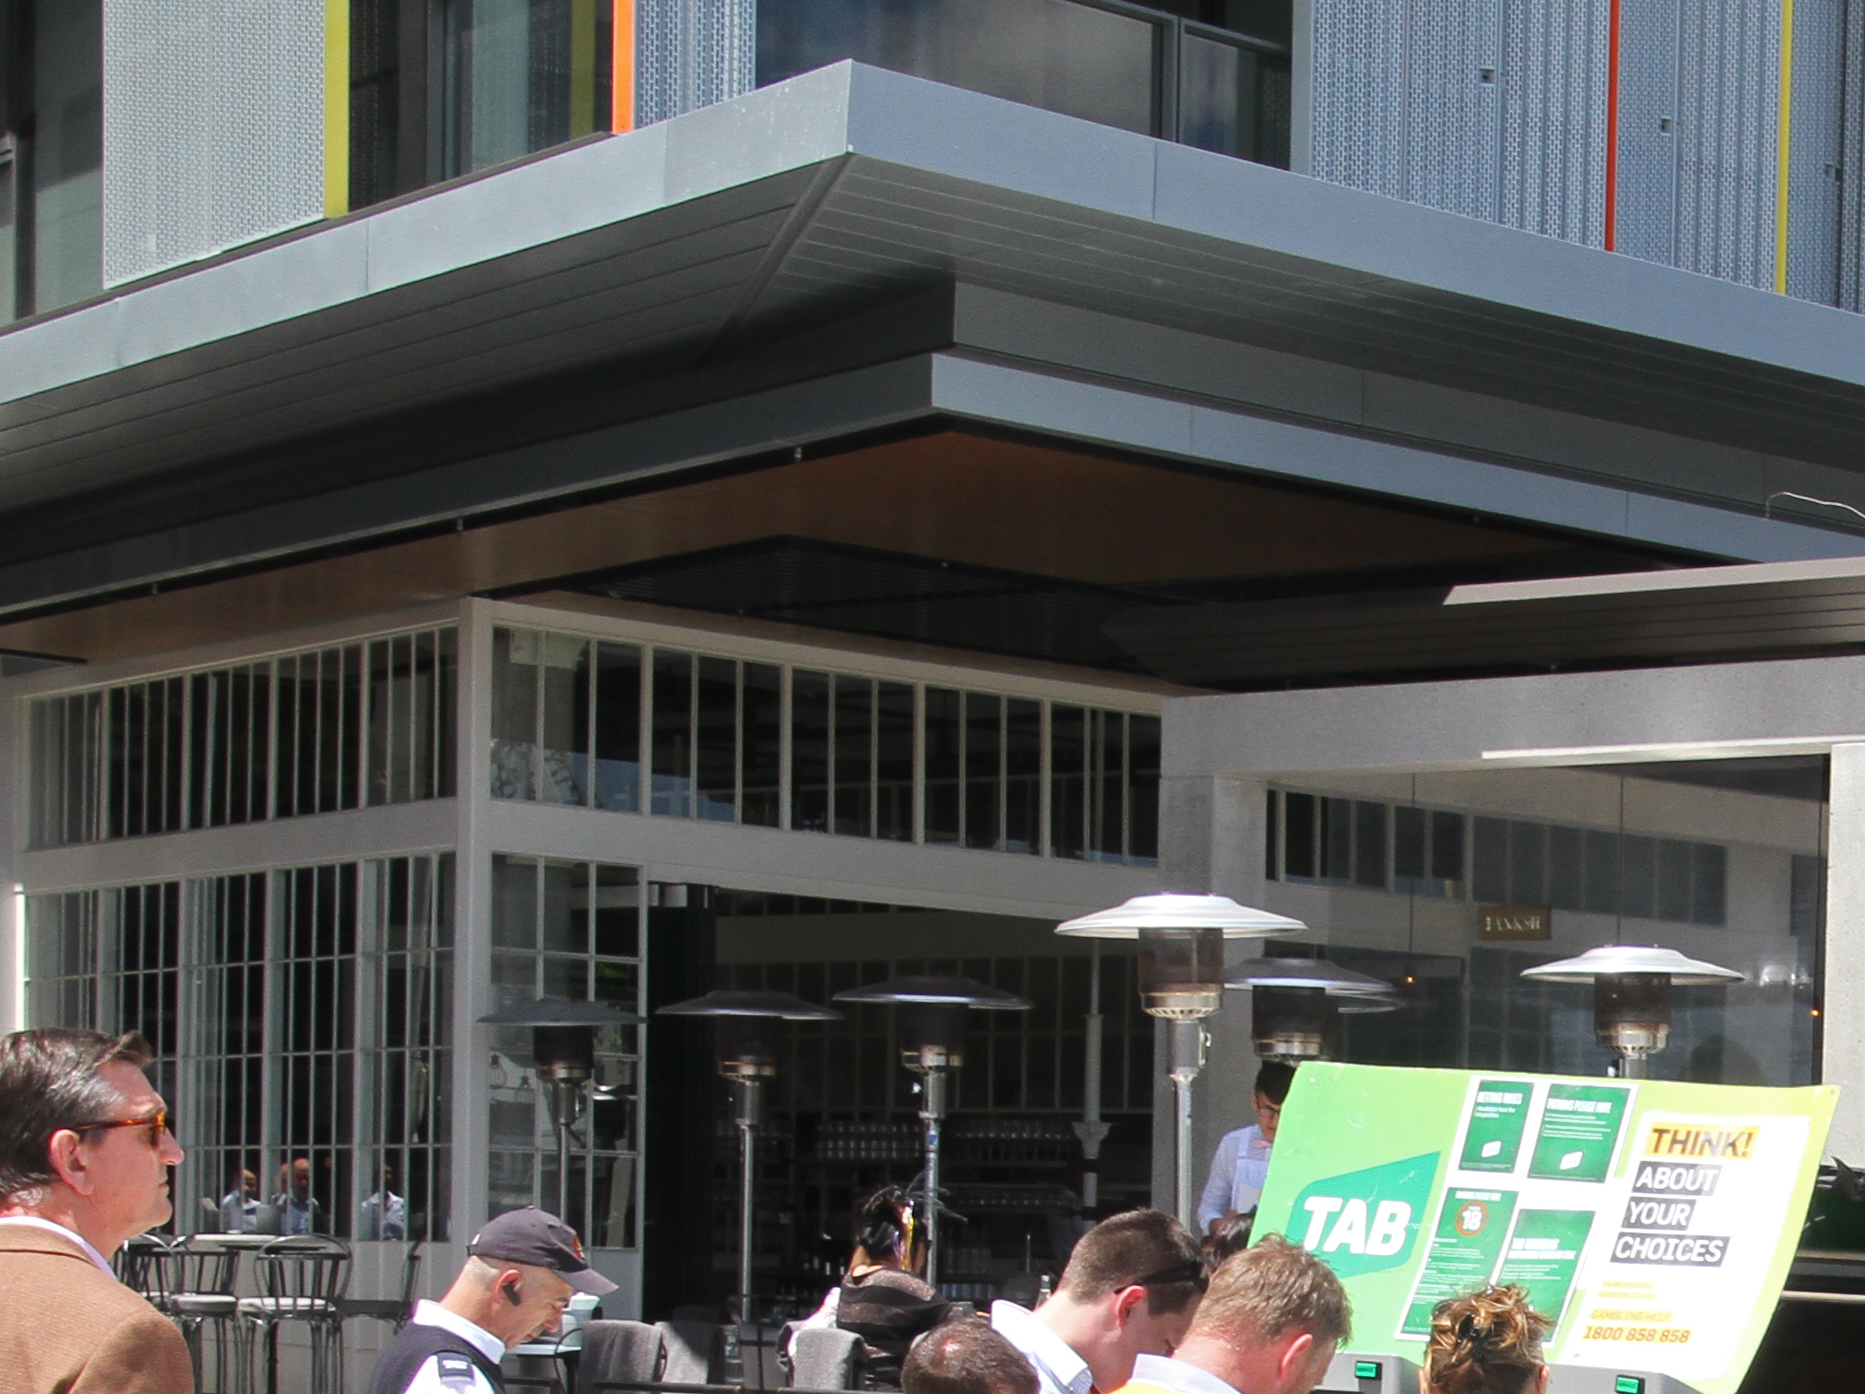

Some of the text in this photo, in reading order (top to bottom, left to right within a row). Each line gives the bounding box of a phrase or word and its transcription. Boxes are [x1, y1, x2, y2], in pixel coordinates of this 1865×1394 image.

[1652, 1128, 1754, 1158] THINK!
[1636, 1166, 1720, 1191] ABOUT
[1303, 1196, 1411, 1256] TAB
[1462, 1210, 1482, 1230] 18
[1630, 1201, 1691, 1226] YOUR
[1614, 1236, 1724, 1262] CHOICES
[1583, 1326, 1691, 1343] 1800 858 858
